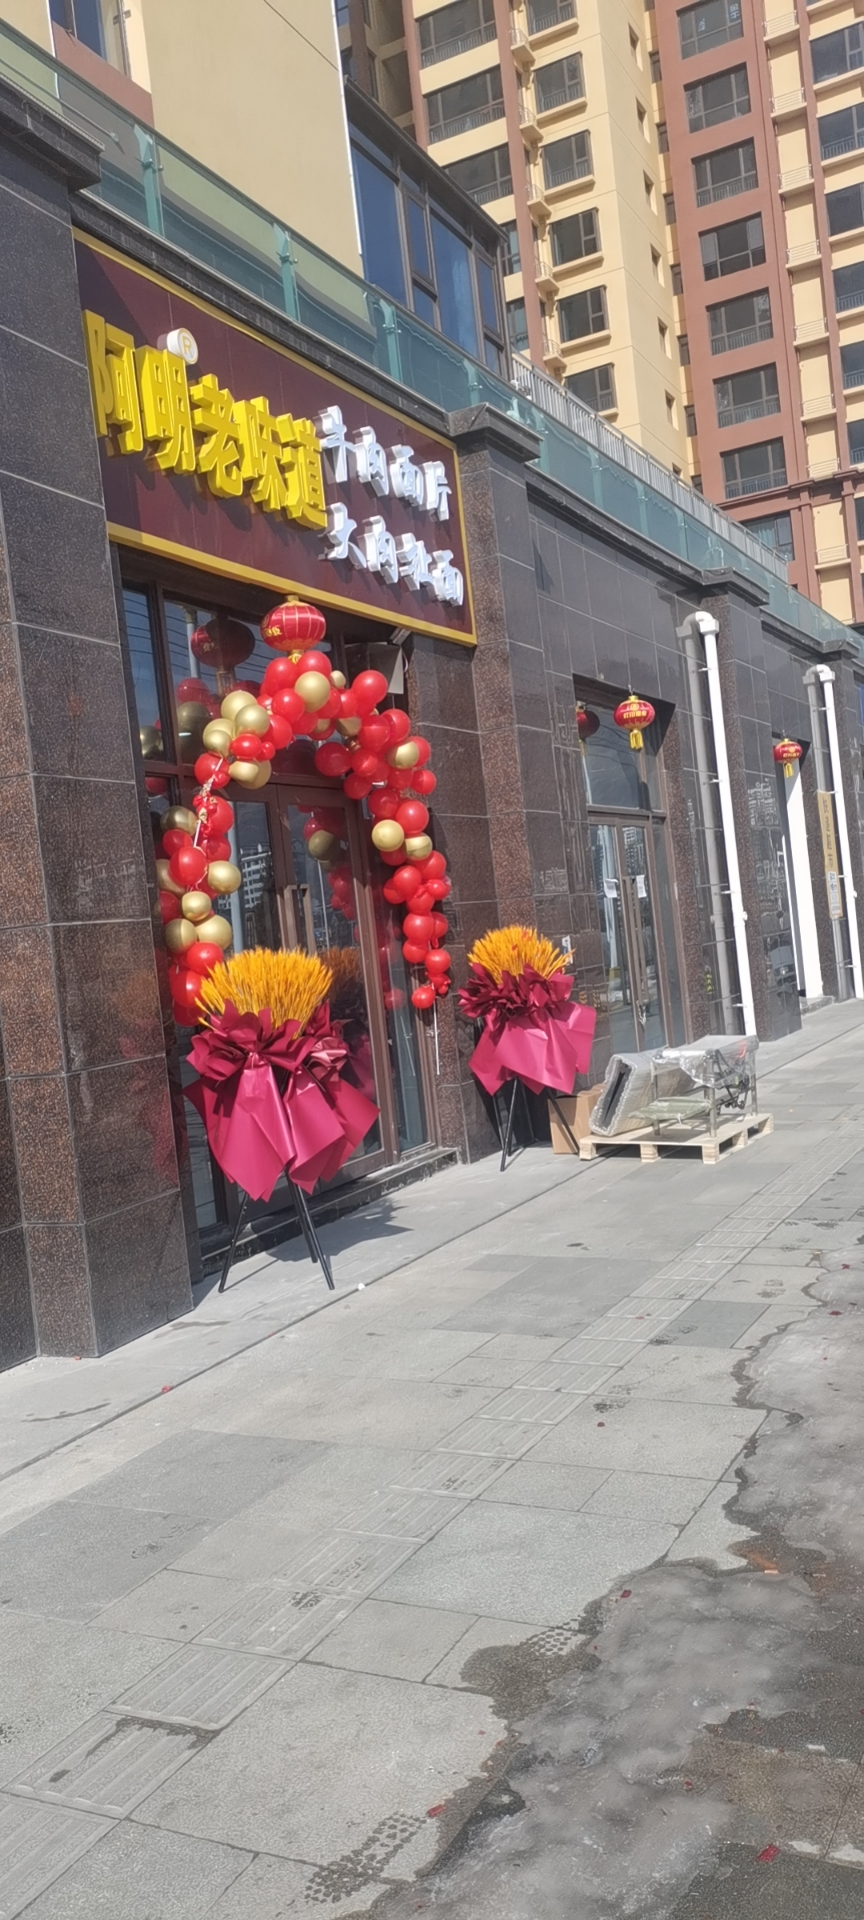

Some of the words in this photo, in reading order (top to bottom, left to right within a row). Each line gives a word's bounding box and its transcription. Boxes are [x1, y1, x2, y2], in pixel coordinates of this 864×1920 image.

[83, 309, 327, 530] 阿明老味道
[319, 405, 452, 521] 牛肉面片
